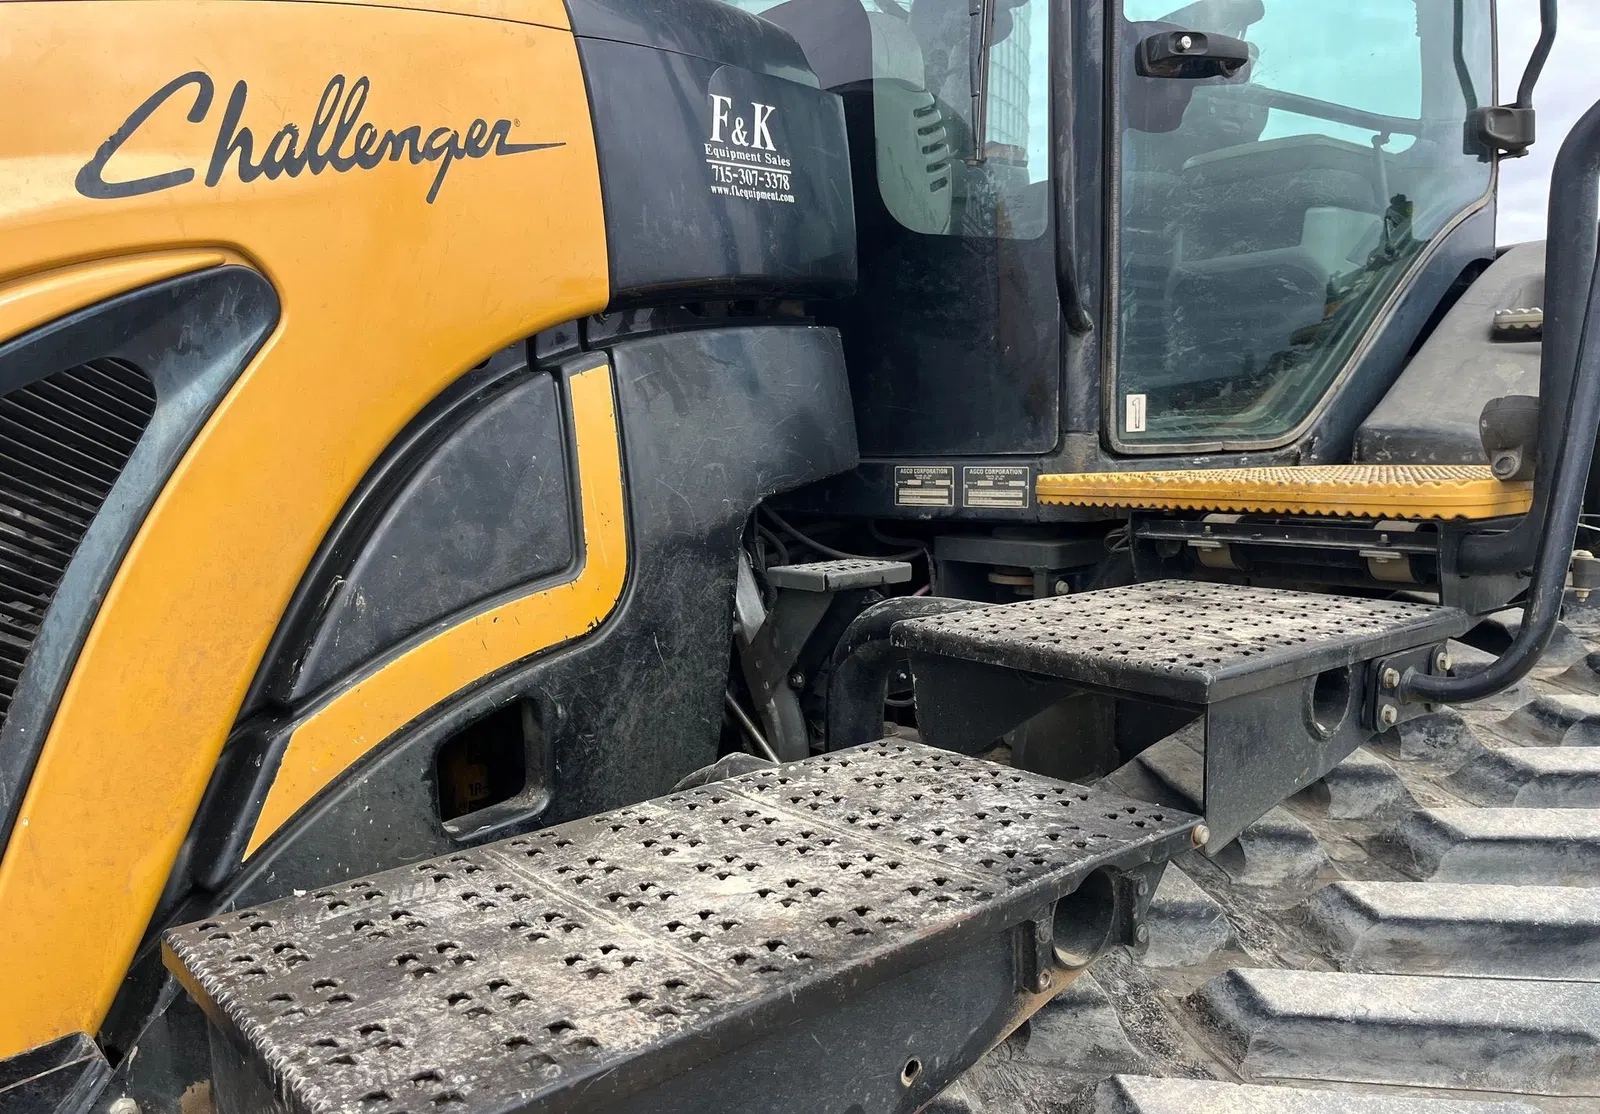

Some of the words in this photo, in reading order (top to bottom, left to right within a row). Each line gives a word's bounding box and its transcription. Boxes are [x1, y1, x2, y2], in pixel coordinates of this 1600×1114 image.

[704, 143, 761, 163] Equipment
[764, 153, 791, 168] Sales
[711, 164, 790, 191] 715-307-3378
[710, 185, 795, 203] www.fkequipment.com
